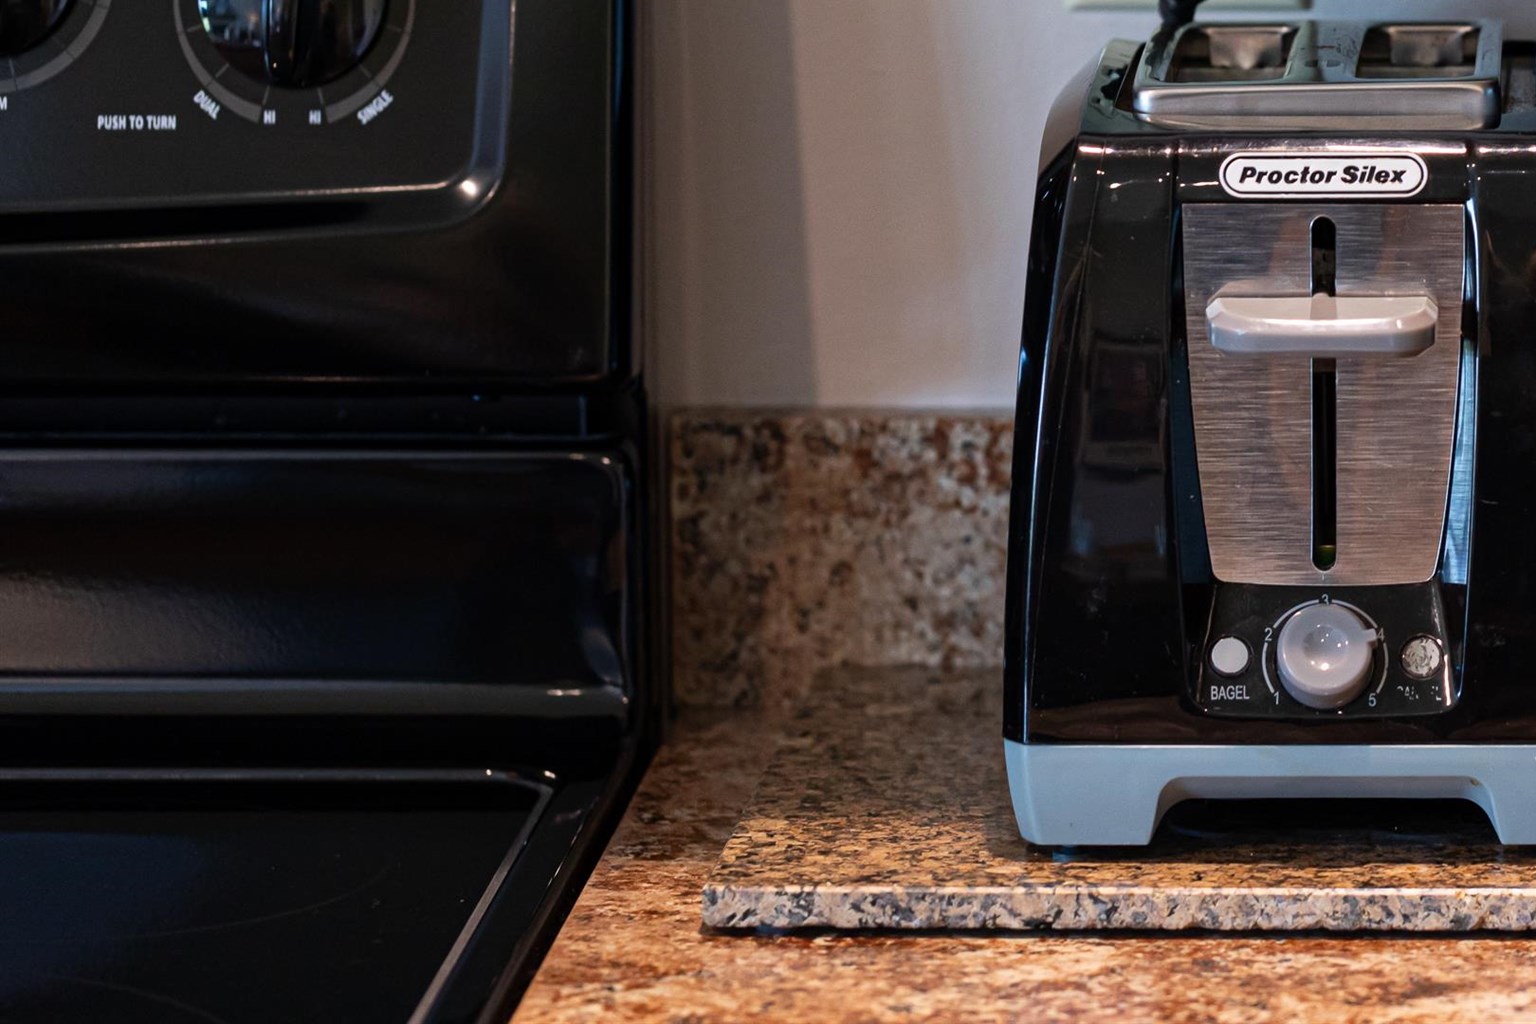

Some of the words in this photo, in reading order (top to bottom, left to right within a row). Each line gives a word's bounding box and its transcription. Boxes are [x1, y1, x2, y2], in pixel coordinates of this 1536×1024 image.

[193, 89, 221, 120] DUAL
[356, 88, 394, 125] SINGLE
[97, 114, 127, 130] PUSH
[128, 114, 144, 130] TO
[146, 114, 177, 130] TURN
[263, 108, 276, 125] HI
[308, 108, 322, 125] HI
[1238, 165, 1337, 185] Proctor
[1340, 165, 1407, 185] Silex
[1264, 627, 1273, 642] 2
[1210, 684, 1250, 701] BAGEL
[1273, 690, 1280, 705] 1
[1368, 692, 1377, 707] 5
